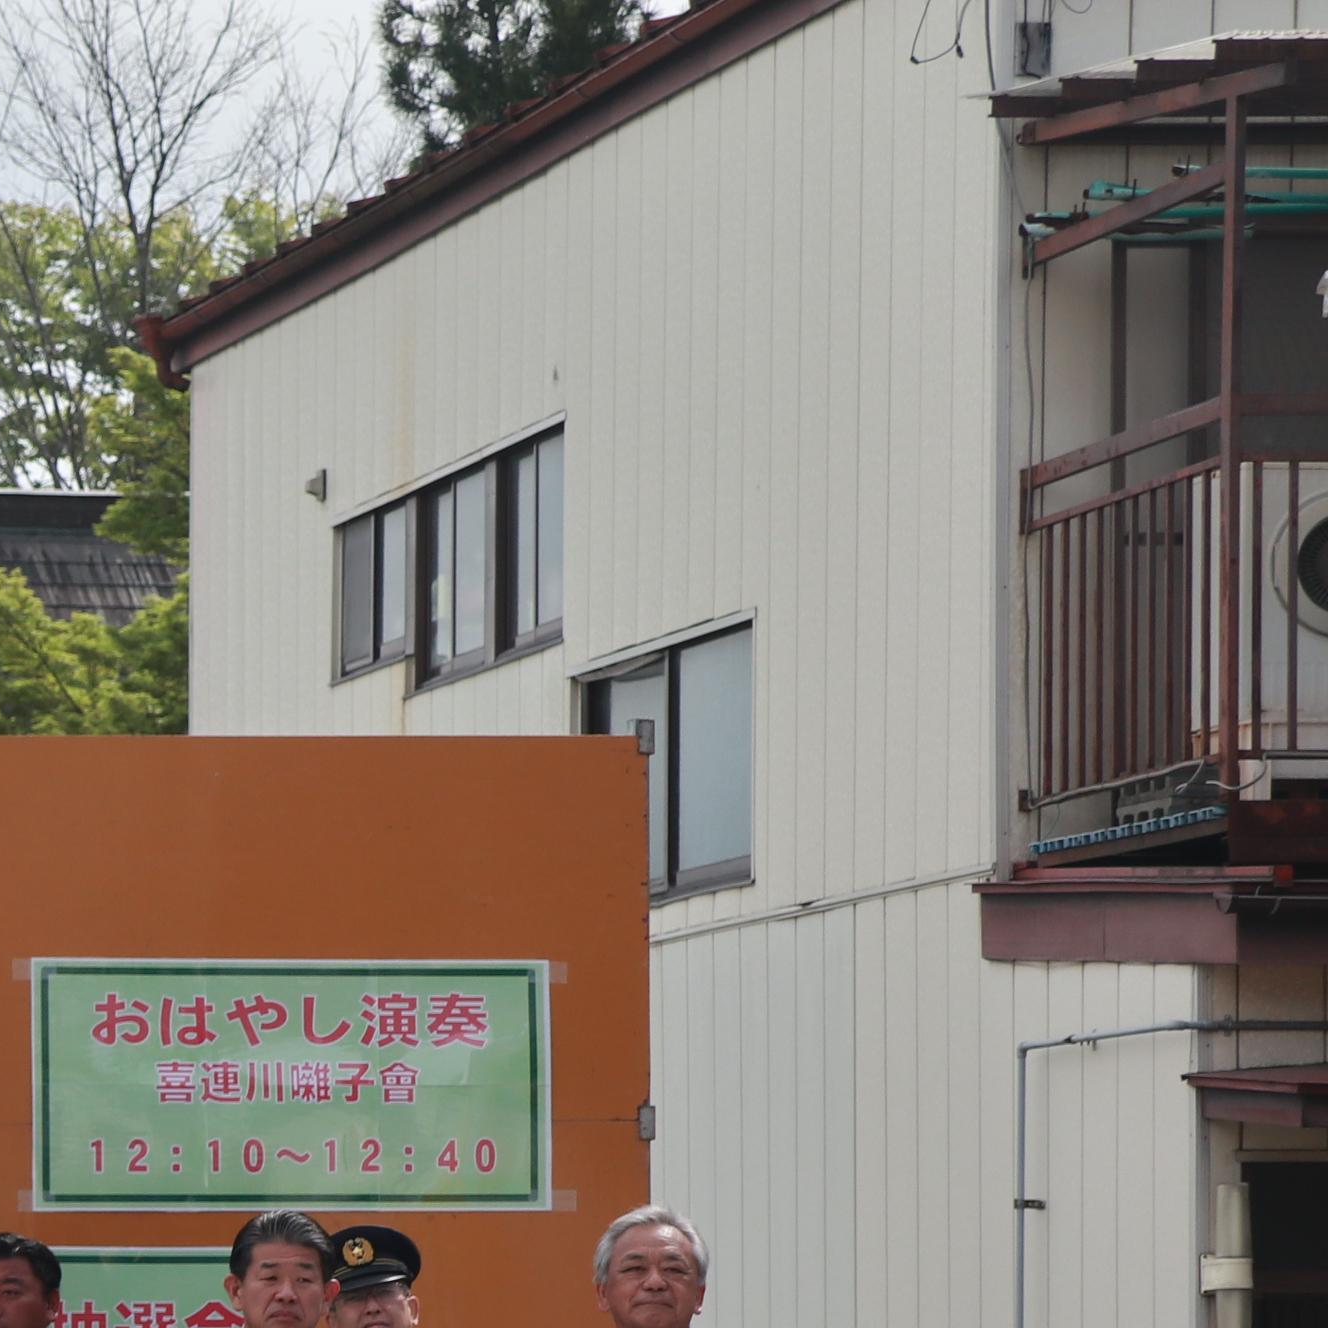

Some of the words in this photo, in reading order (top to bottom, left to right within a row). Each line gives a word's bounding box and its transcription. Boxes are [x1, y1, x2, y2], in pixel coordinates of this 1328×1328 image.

[90, 992, 489, 1049] おはやし演奏
